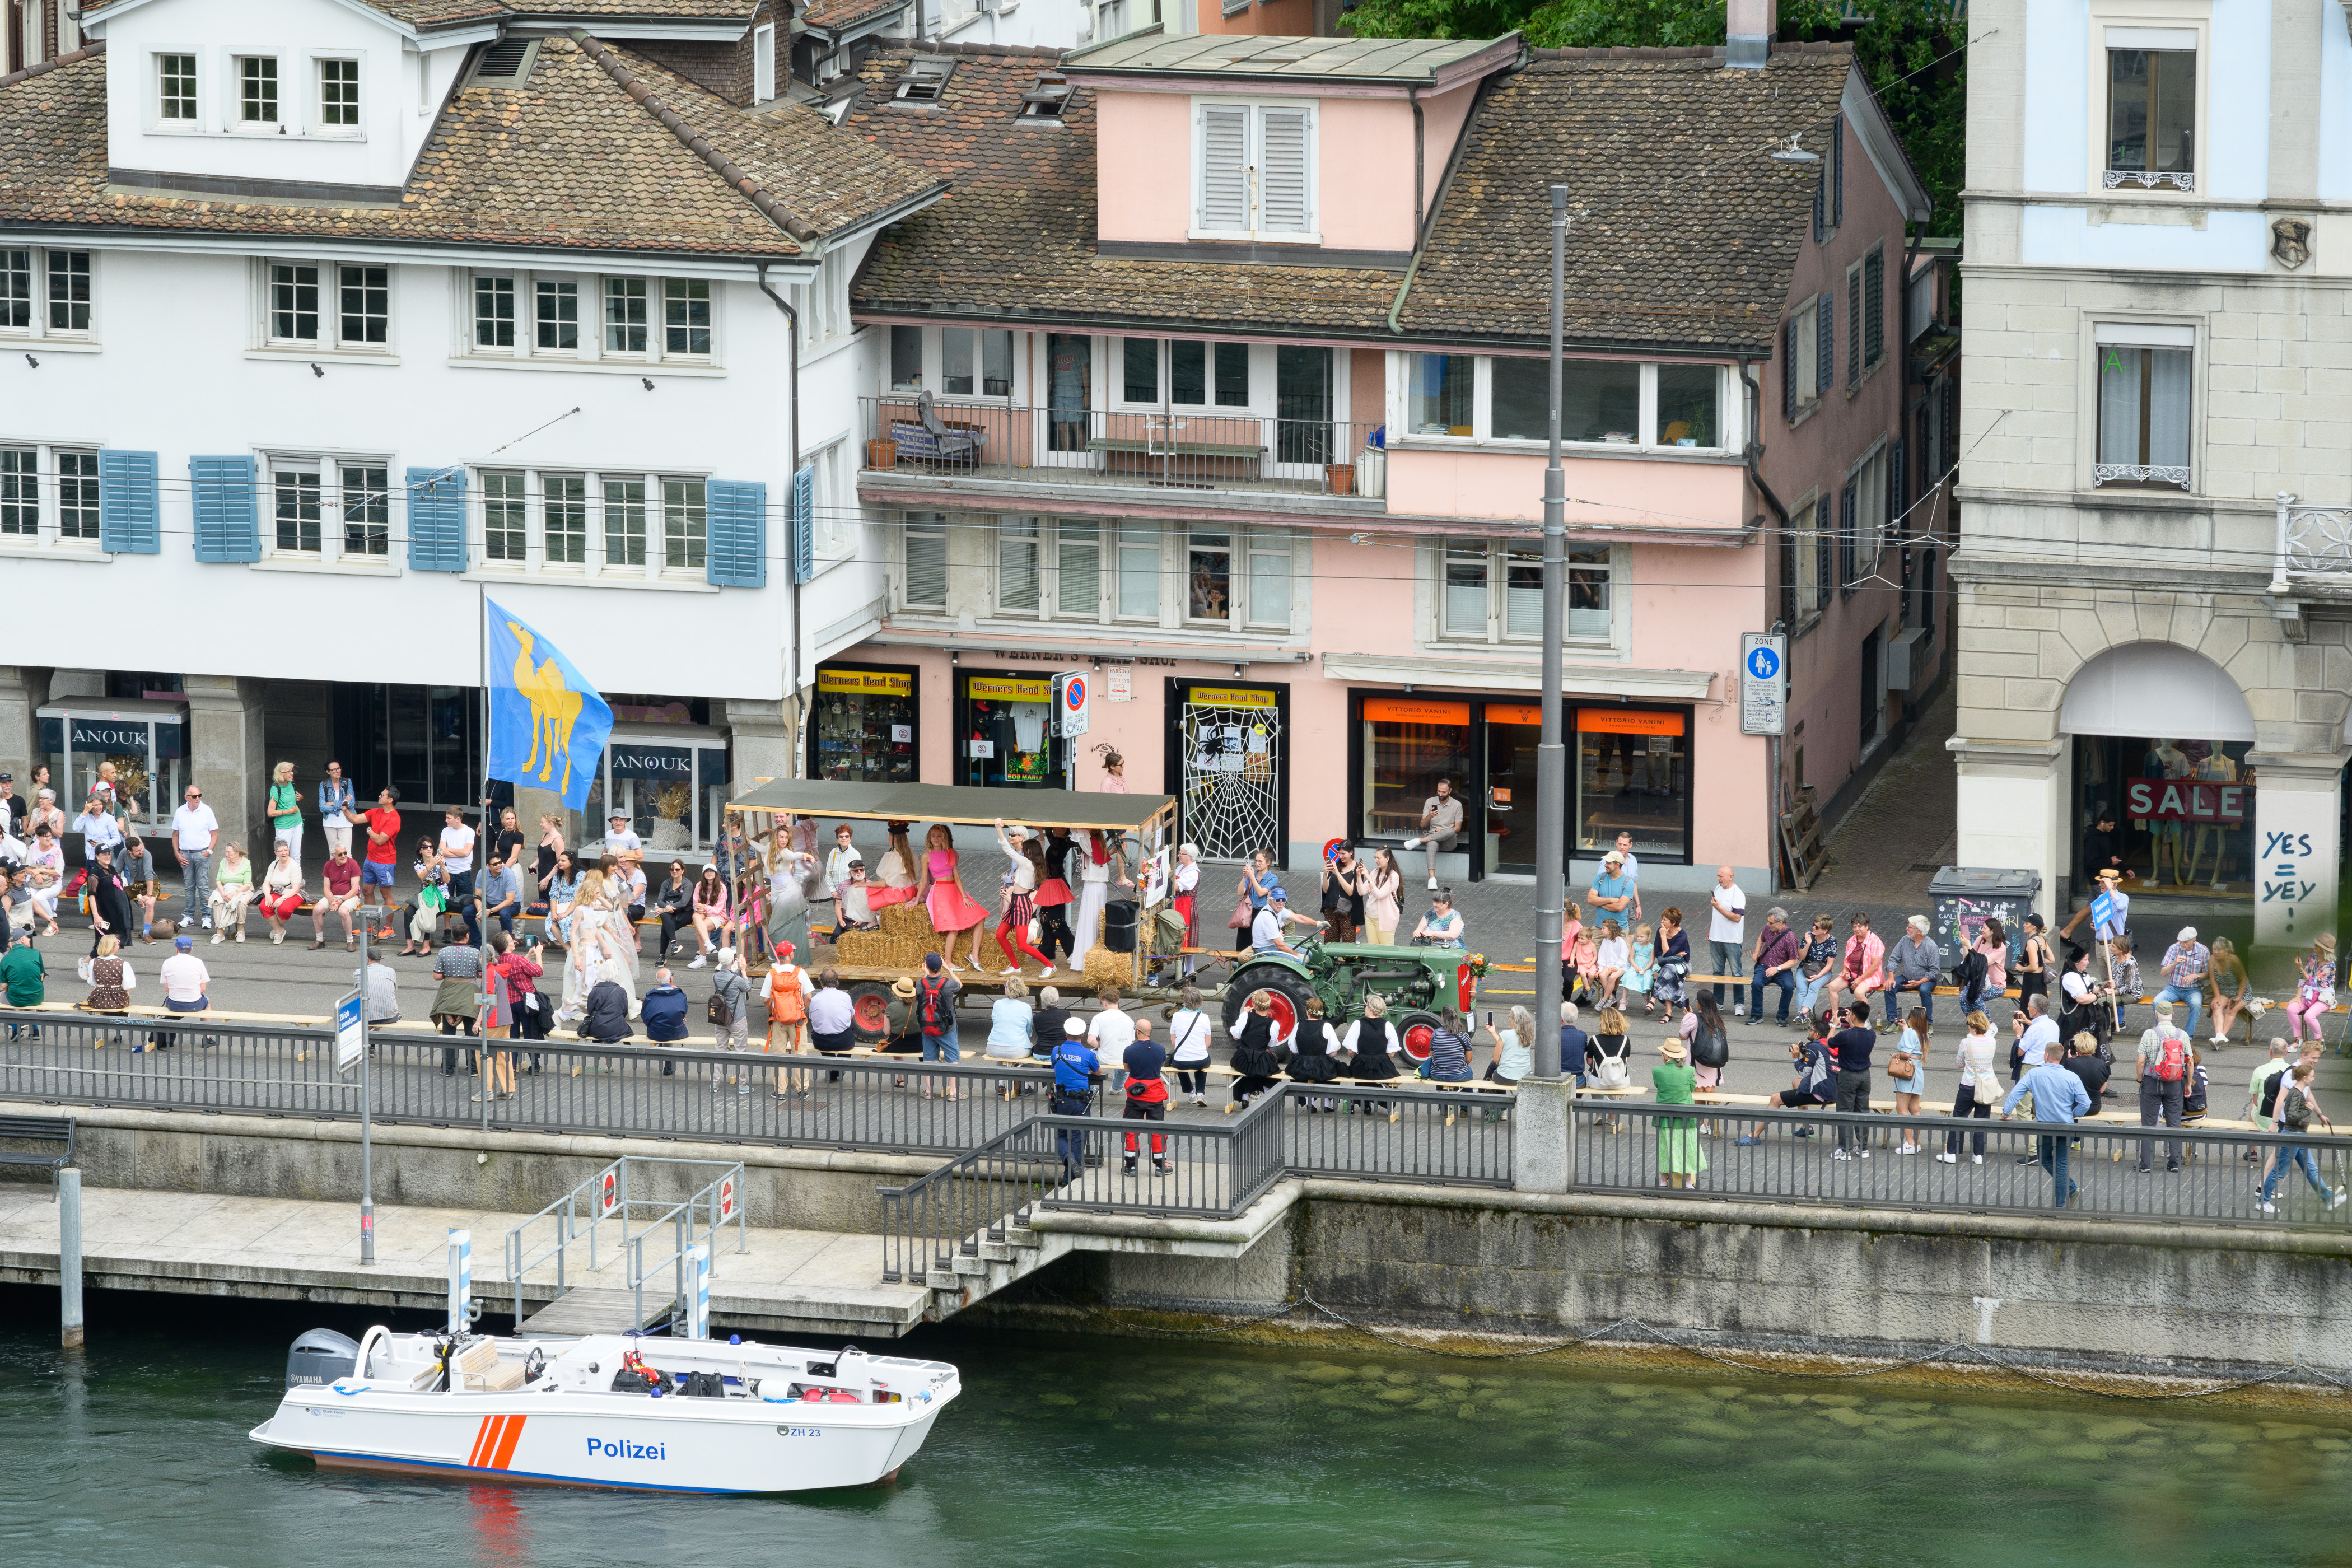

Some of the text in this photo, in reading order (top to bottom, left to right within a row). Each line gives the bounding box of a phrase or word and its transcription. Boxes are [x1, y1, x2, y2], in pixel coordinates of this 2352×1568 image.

[820, 674, 860, 687] Werners
[863, 675, 886, 688] Head
[973, 681, 1014, 694] Werners
[1016, 684, 1040, 696] Head
[1197, 691, 1269, 704] Werners Head Shop
[72, 730, 148, 745] ANOUK
[613, 755, 691, 771] ANOUK
[2130, 784, 2242, 816] SALE
[2262, 831, 2312, 859] YES
[2262, 880, 2316, 902] YEY
[339, 1010, 349, 1021] Zürich
[339, 1013, 357, 1030] Limmatquai
[1055, 1054, 1082, 1062] POLIZEI
[296, 1375, 323, 1384] YAMAHA
[791, 1428, 821, 1437] ZH 23
[587, 1438, 665, 1460] Polizei
